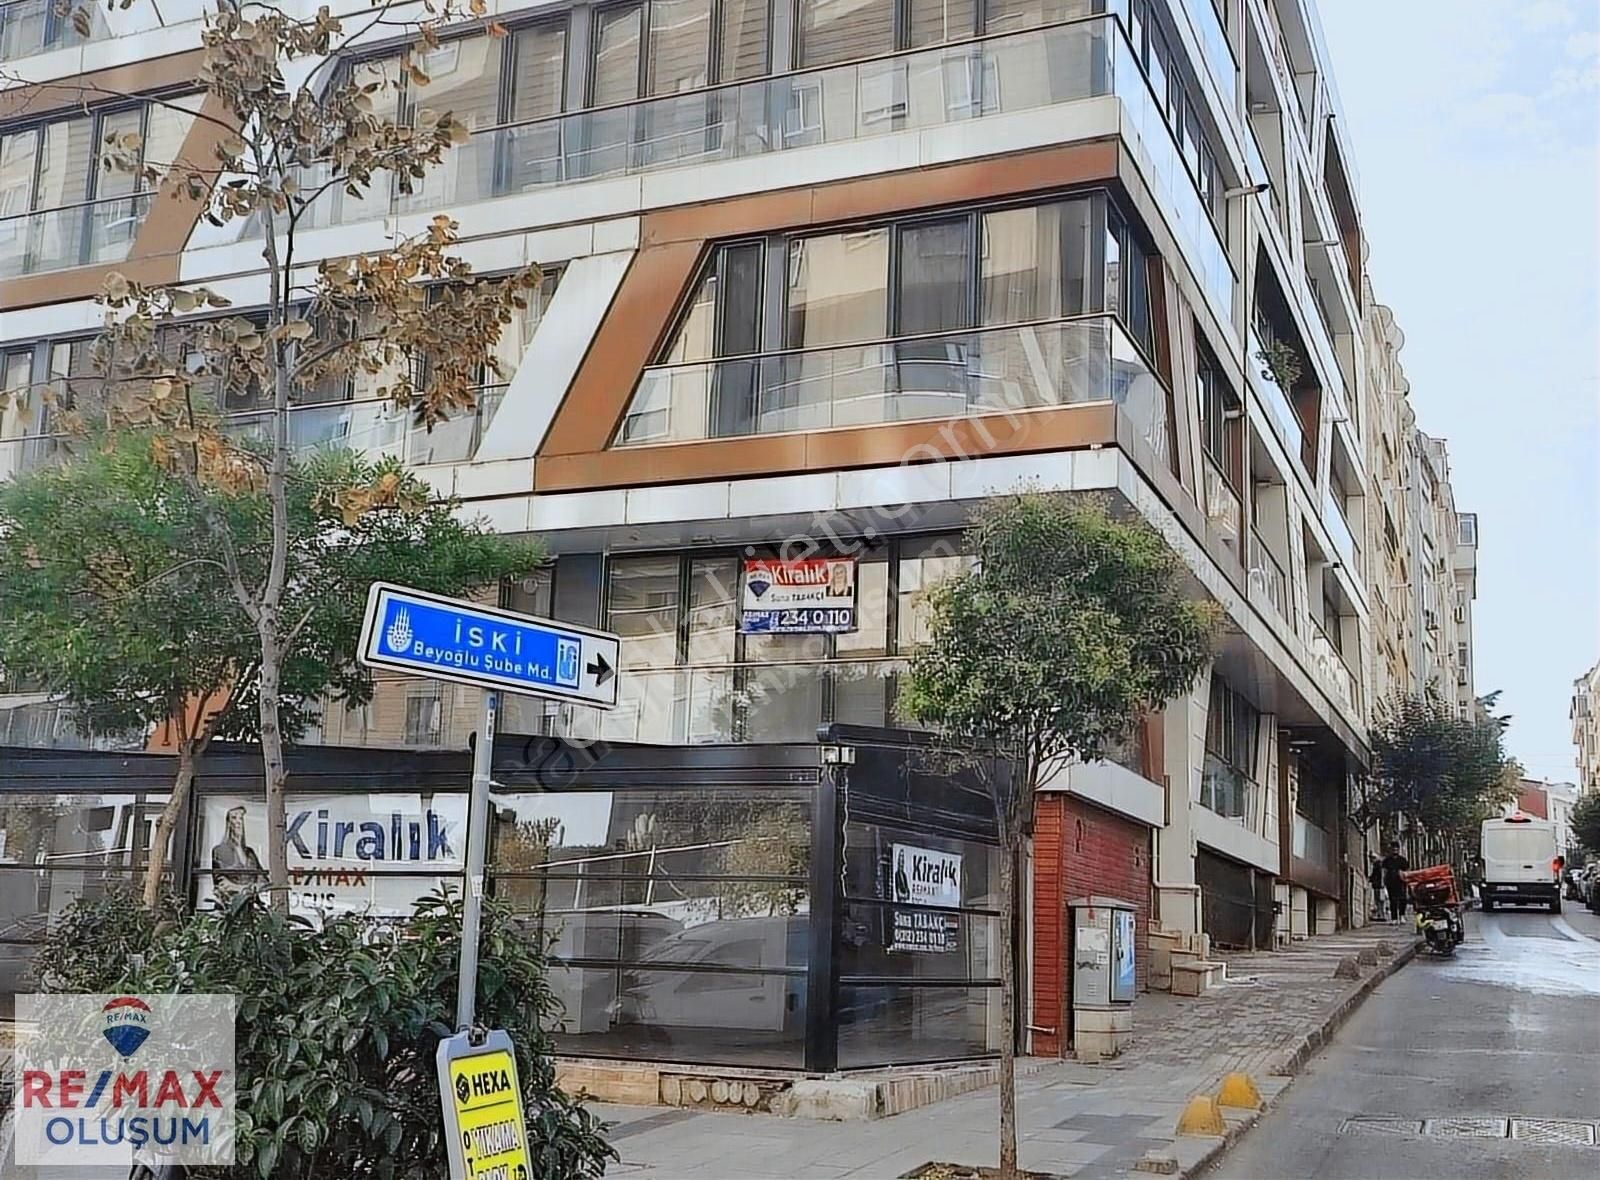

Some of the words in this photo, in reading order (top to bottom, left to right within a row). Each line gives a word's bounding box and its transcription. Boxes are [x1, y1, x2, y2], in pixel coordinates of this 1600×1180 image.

[780, 610, 808, 626] 234
[455, 618, 522, 656] İSKİ
[413, 640, 479, 667] Beyoğlu
[484, 654, 522, 673] Şube
[286, 809, 456, 860] Kiralık
[912, 855, 957, 886] Kiralık
[472, 1070, 511, 1096] HEXA
